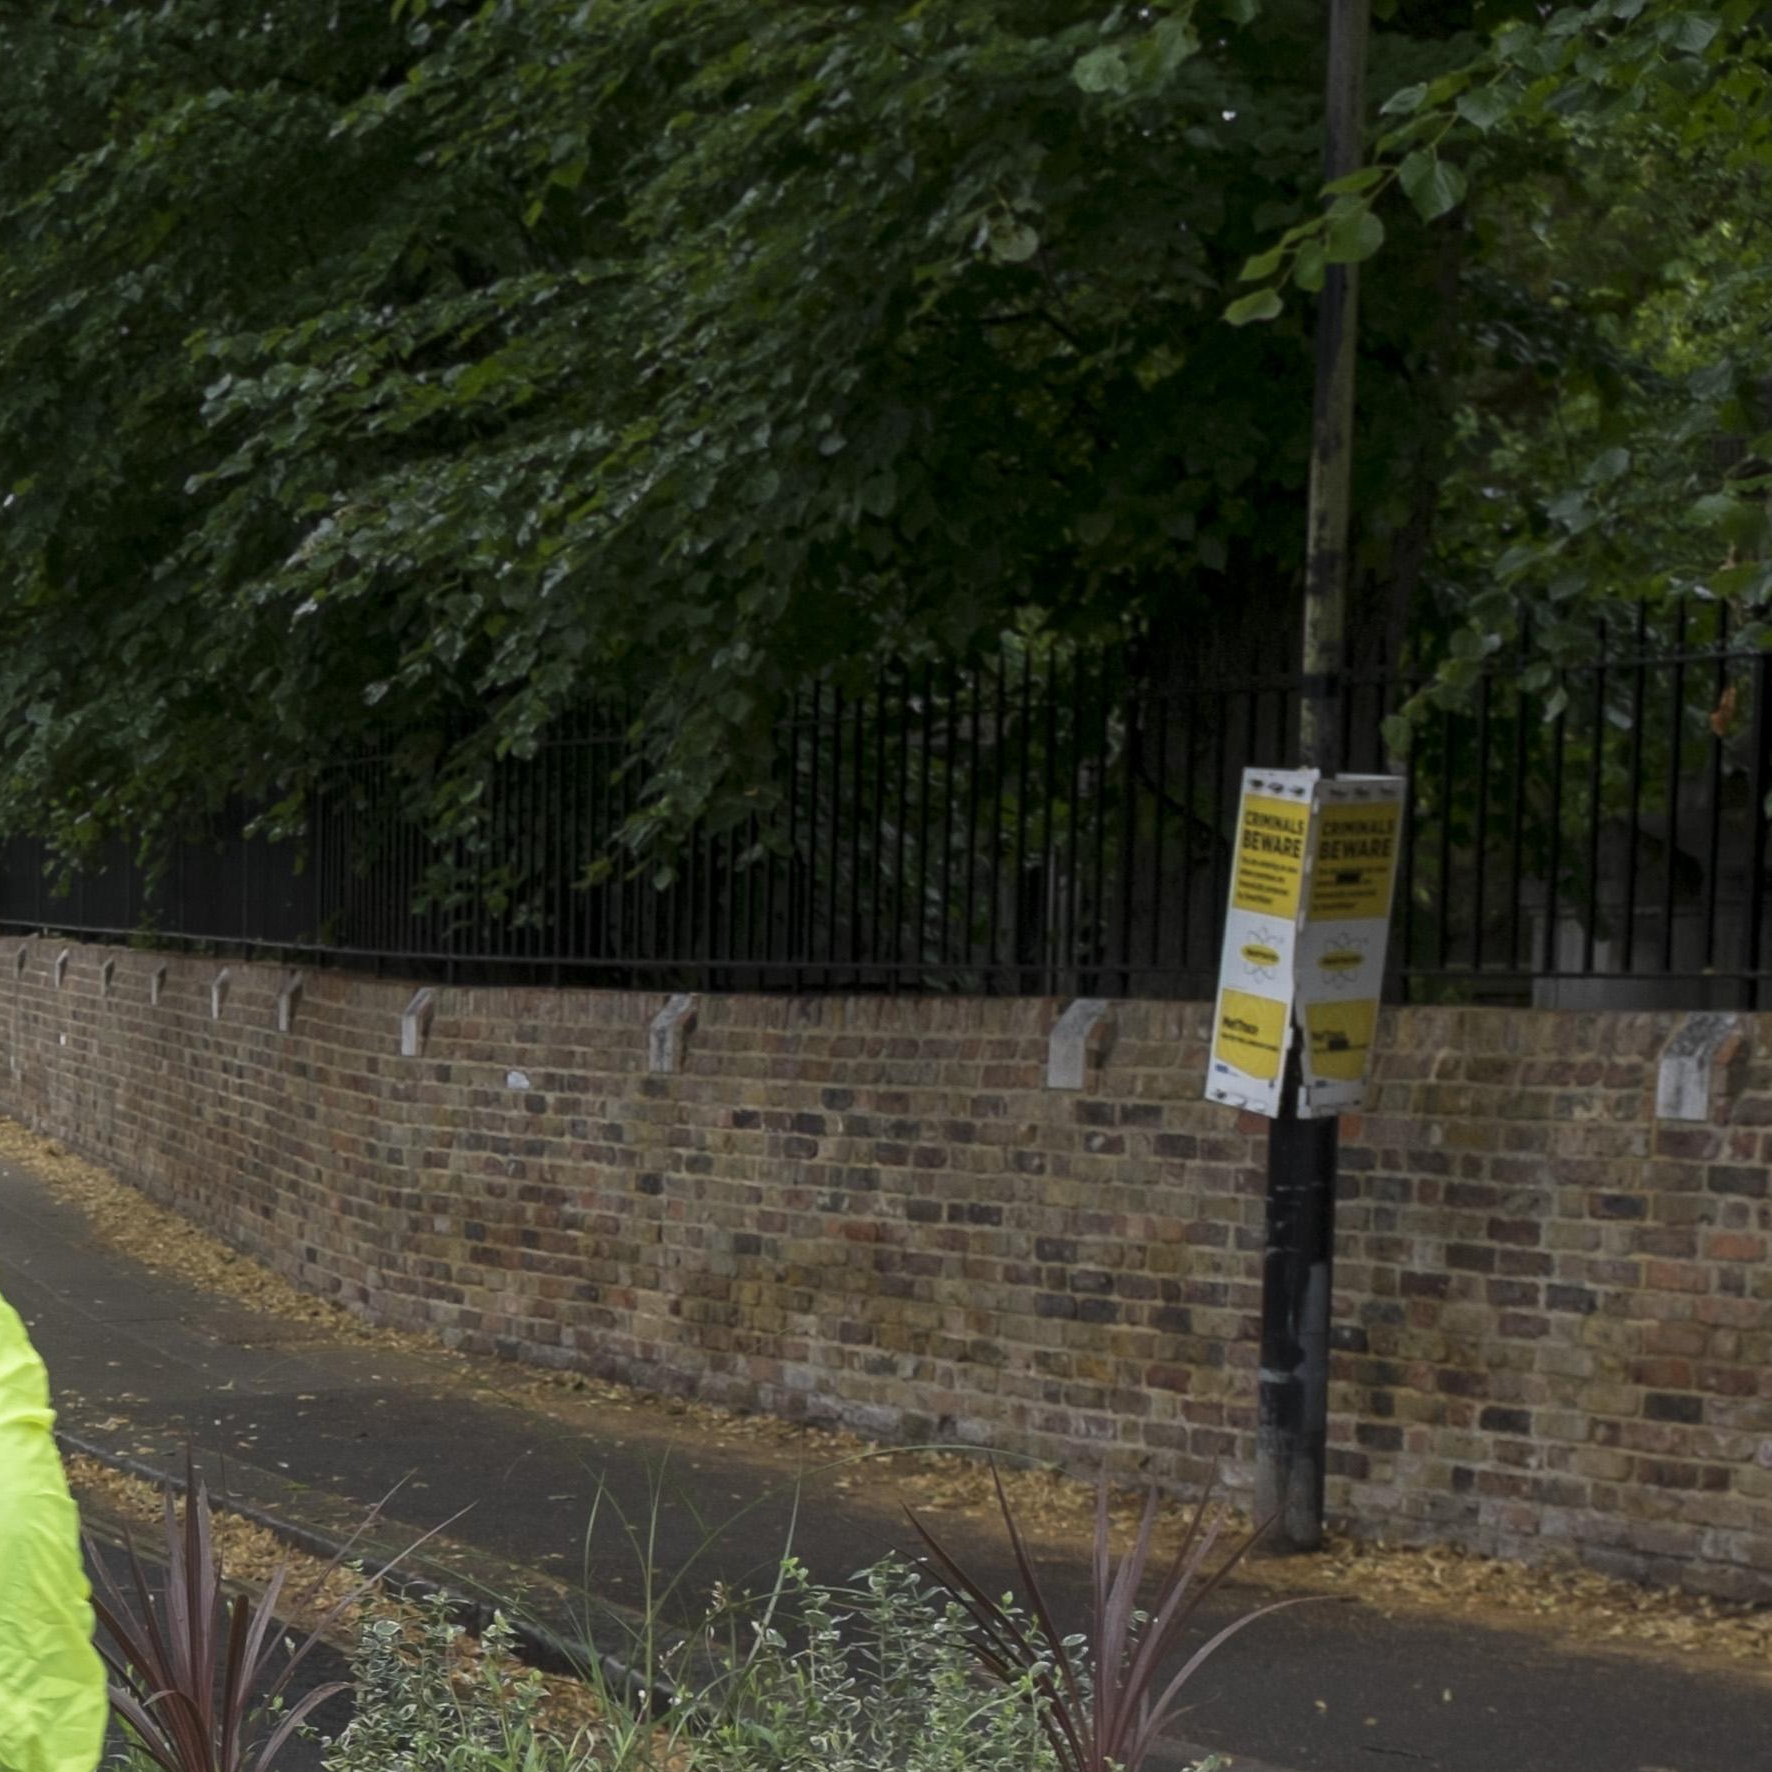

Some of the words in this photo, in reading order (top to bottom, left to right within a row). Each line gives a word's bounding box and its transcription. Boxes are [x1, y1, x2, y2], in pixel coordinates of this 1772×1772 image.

[1244, 810, 1305, 835] CRIMINALS
[1322, 818, 1395, 836] CRIMINALS
[1242, 829, 1302, 858] BEWARE
[1319, 838, 1392, 860] BEWARE
